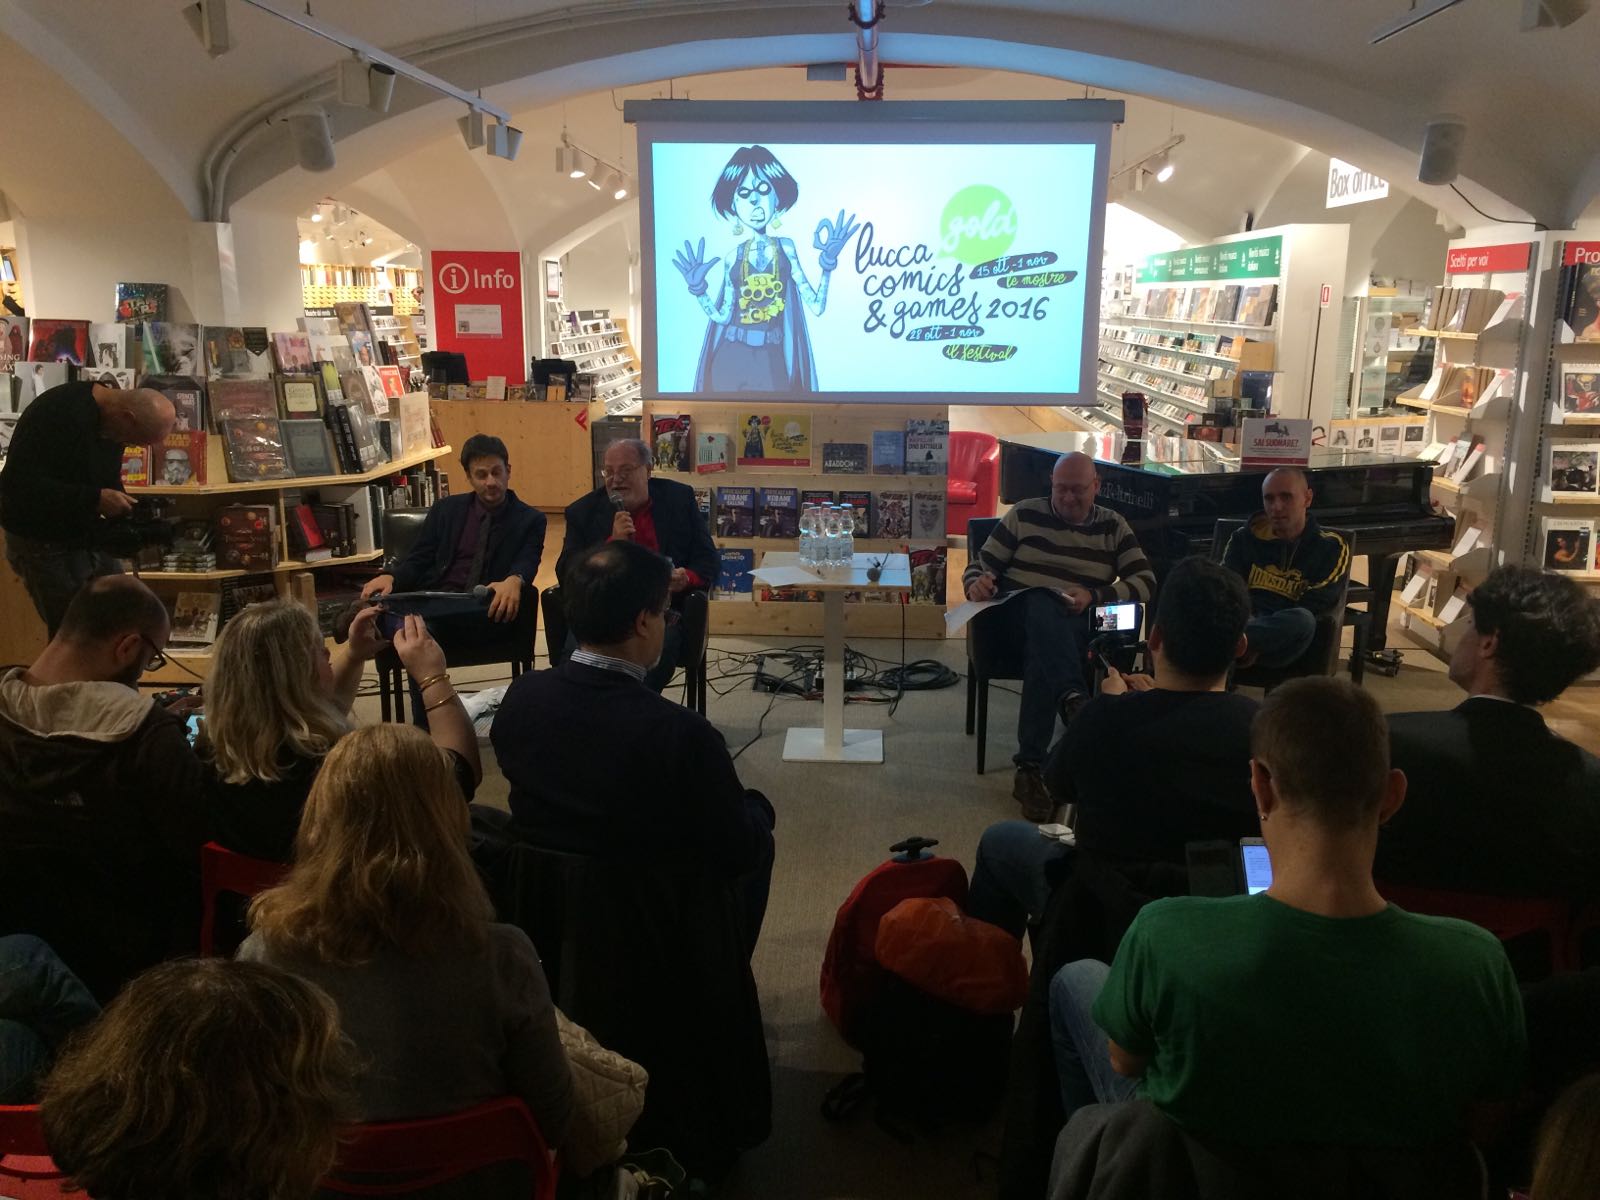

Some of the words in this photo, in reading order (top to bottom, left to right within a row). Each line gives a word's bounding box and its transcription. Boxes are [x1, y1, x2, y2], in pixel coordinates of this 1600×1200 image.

[1330, 168, 1350, 198] Box
[942, 200, 1016, 252] gold
[855, 221, 933, 274] lucca
[977, 265, 990, 277] 15
[993, 256, 1010, 274] ott
[1026, 256, 1048, 266] nov
[1450, 252, 1467, 268] Scelti
[1467, 257, 1478, 271] per
[1478, 251, 1489, 266] voi
[473, 268, 515, 289] Info
[863, 263, 965, 298] comics
[1006, 271, 1019, 288] le
[1022, 272, 1067, 287] mostre
[863, 299, 887, 333] &
[889, 291, 982, 339] games
[985, 296, 1050, 321] 2016
[909, 328, 922, 340] 28
[924, 325, 942, 340] ott
[959, 328, 980, 337] nov
[961, 344, 1013, 361] festival
